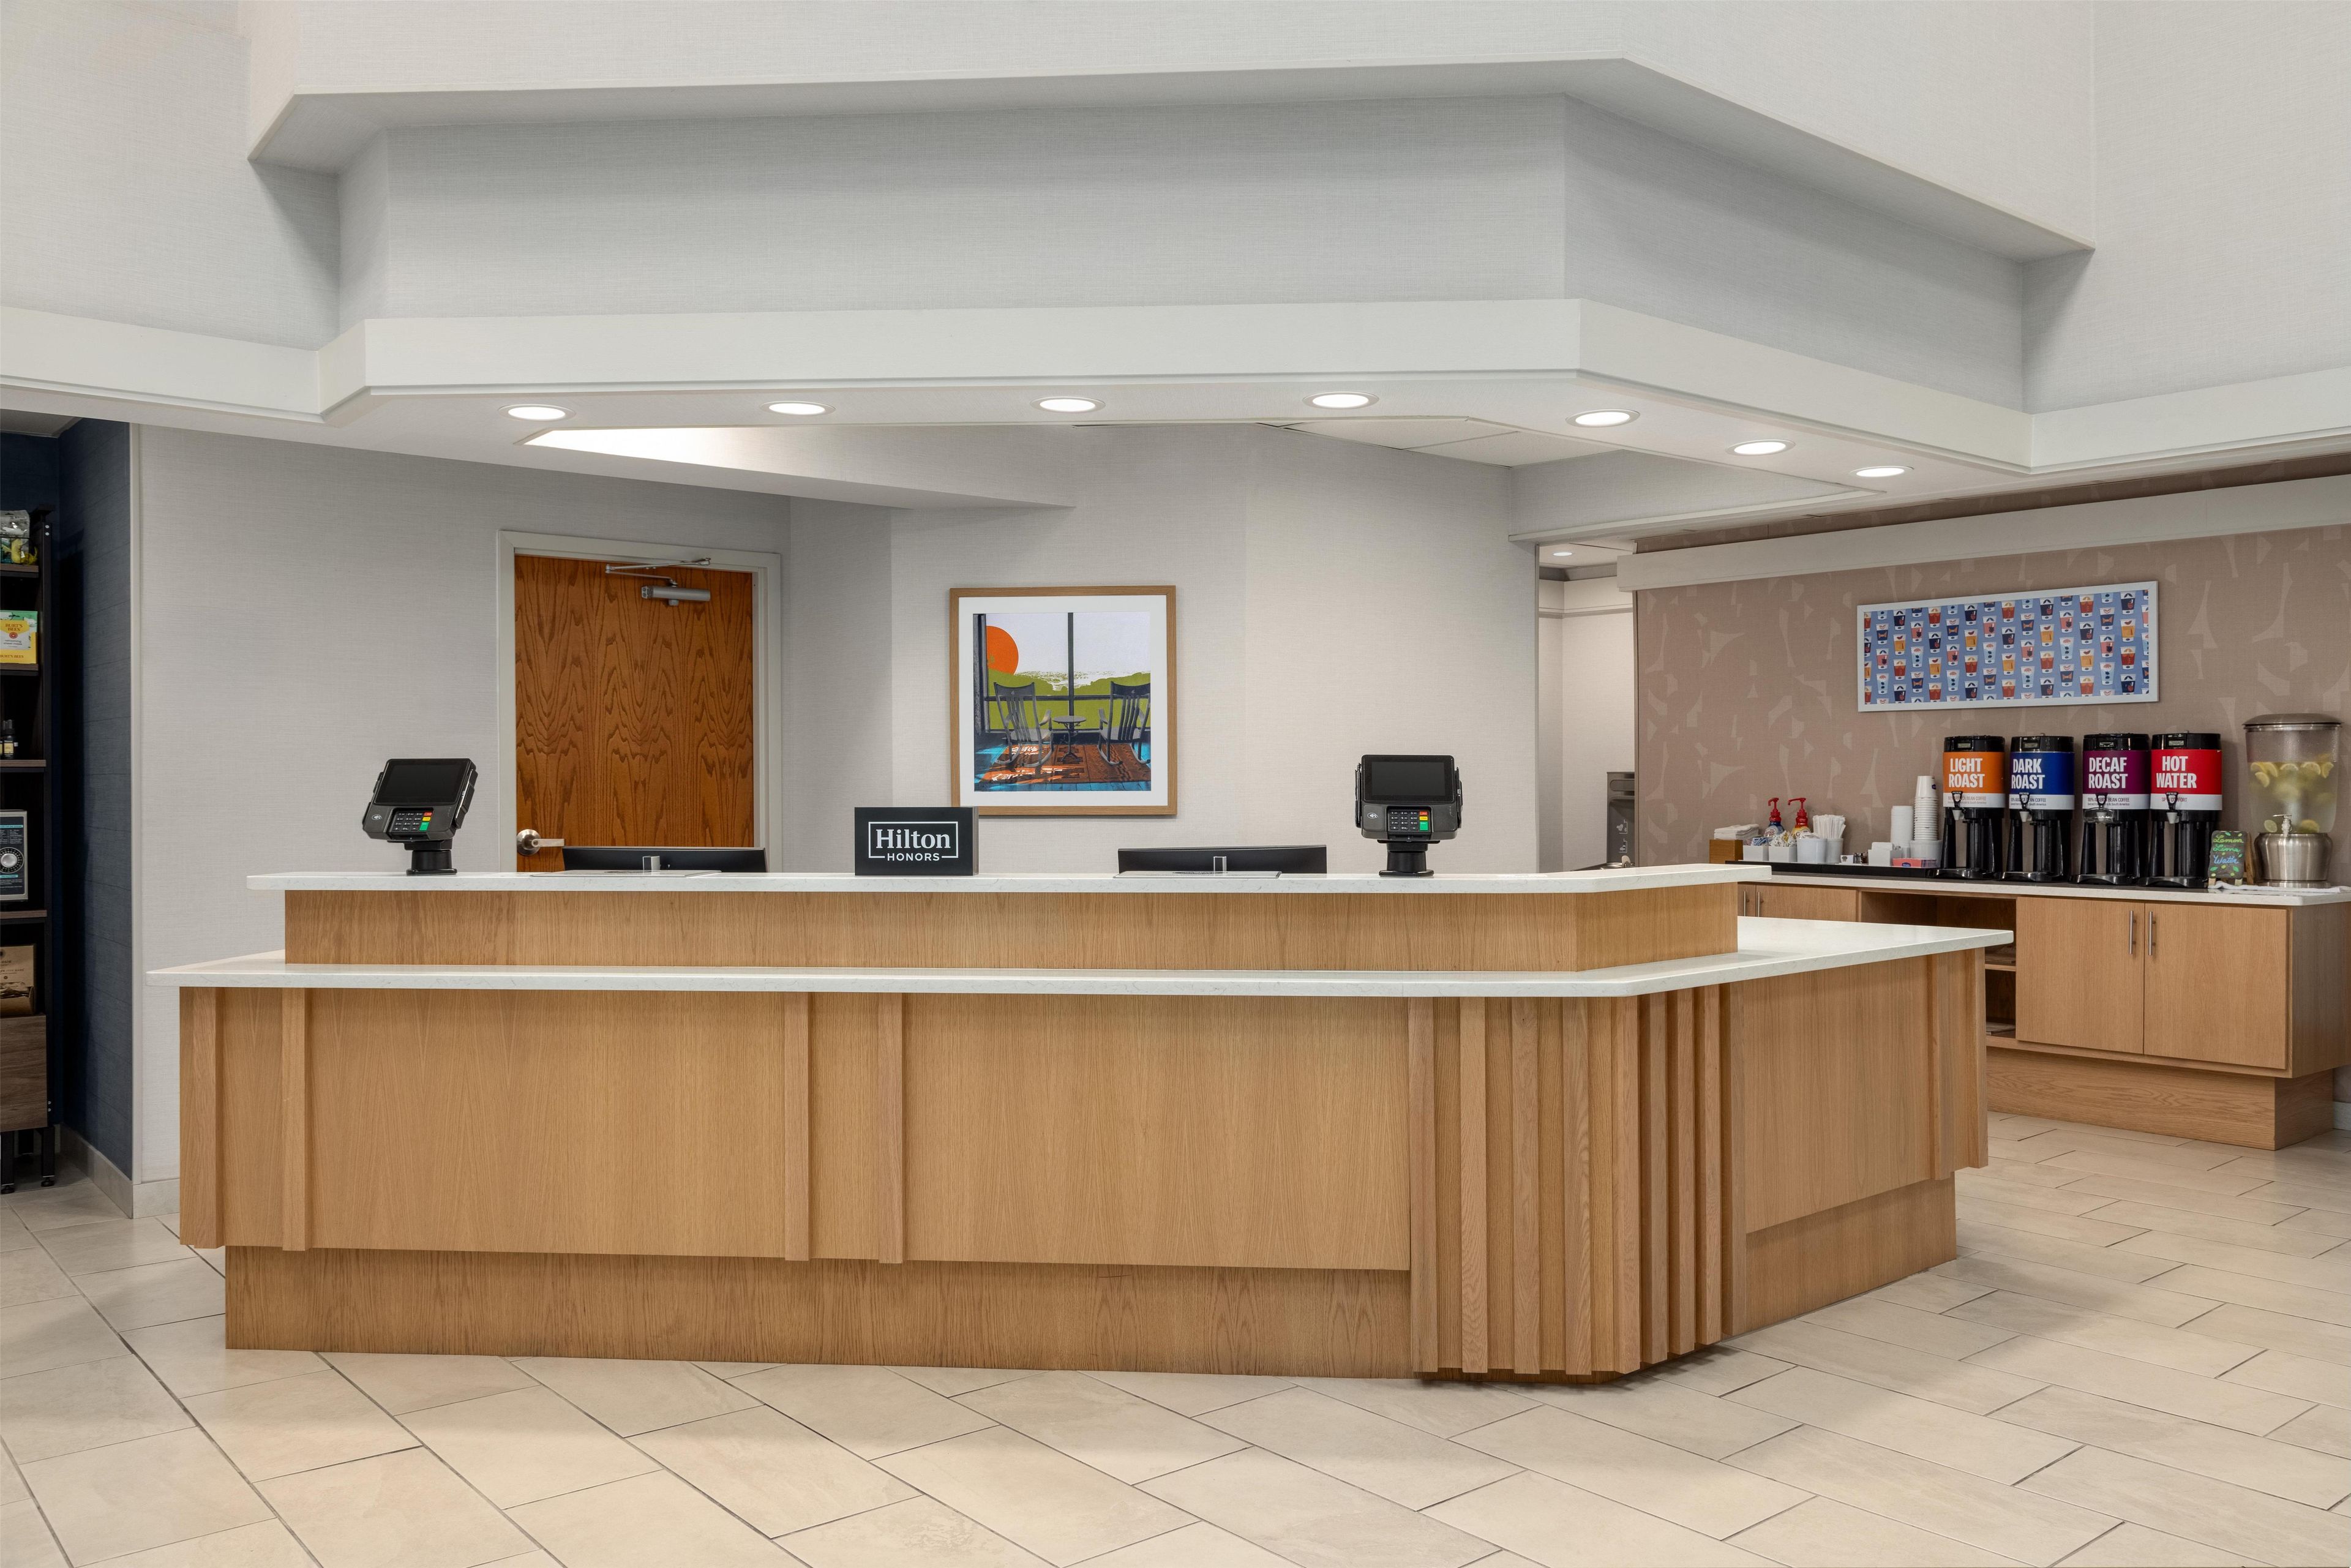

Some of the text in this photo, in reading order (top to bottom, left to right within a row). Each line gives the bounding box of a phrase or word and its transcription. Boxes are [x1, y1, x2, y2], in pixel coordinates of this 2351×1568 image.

[1950, 758, 1983, 772] LIGHT
[2012, 759, 2042, 773] DARK
[2089, 757, 2128, 772] DECAF
[2162, 756, 2189, 771] HOT
[1948, 773, 1985, 788] ROAST
[2011, 775, 2045, 789] ROAST
[2088, 773, 2128, 789] ROAST
[2156, 773, 2197, 789] WATER
[876, 829, 951, 849] Hilton
[887, 853, 940, 861] HONORS
[2213, 855, 2239, 864] Water
